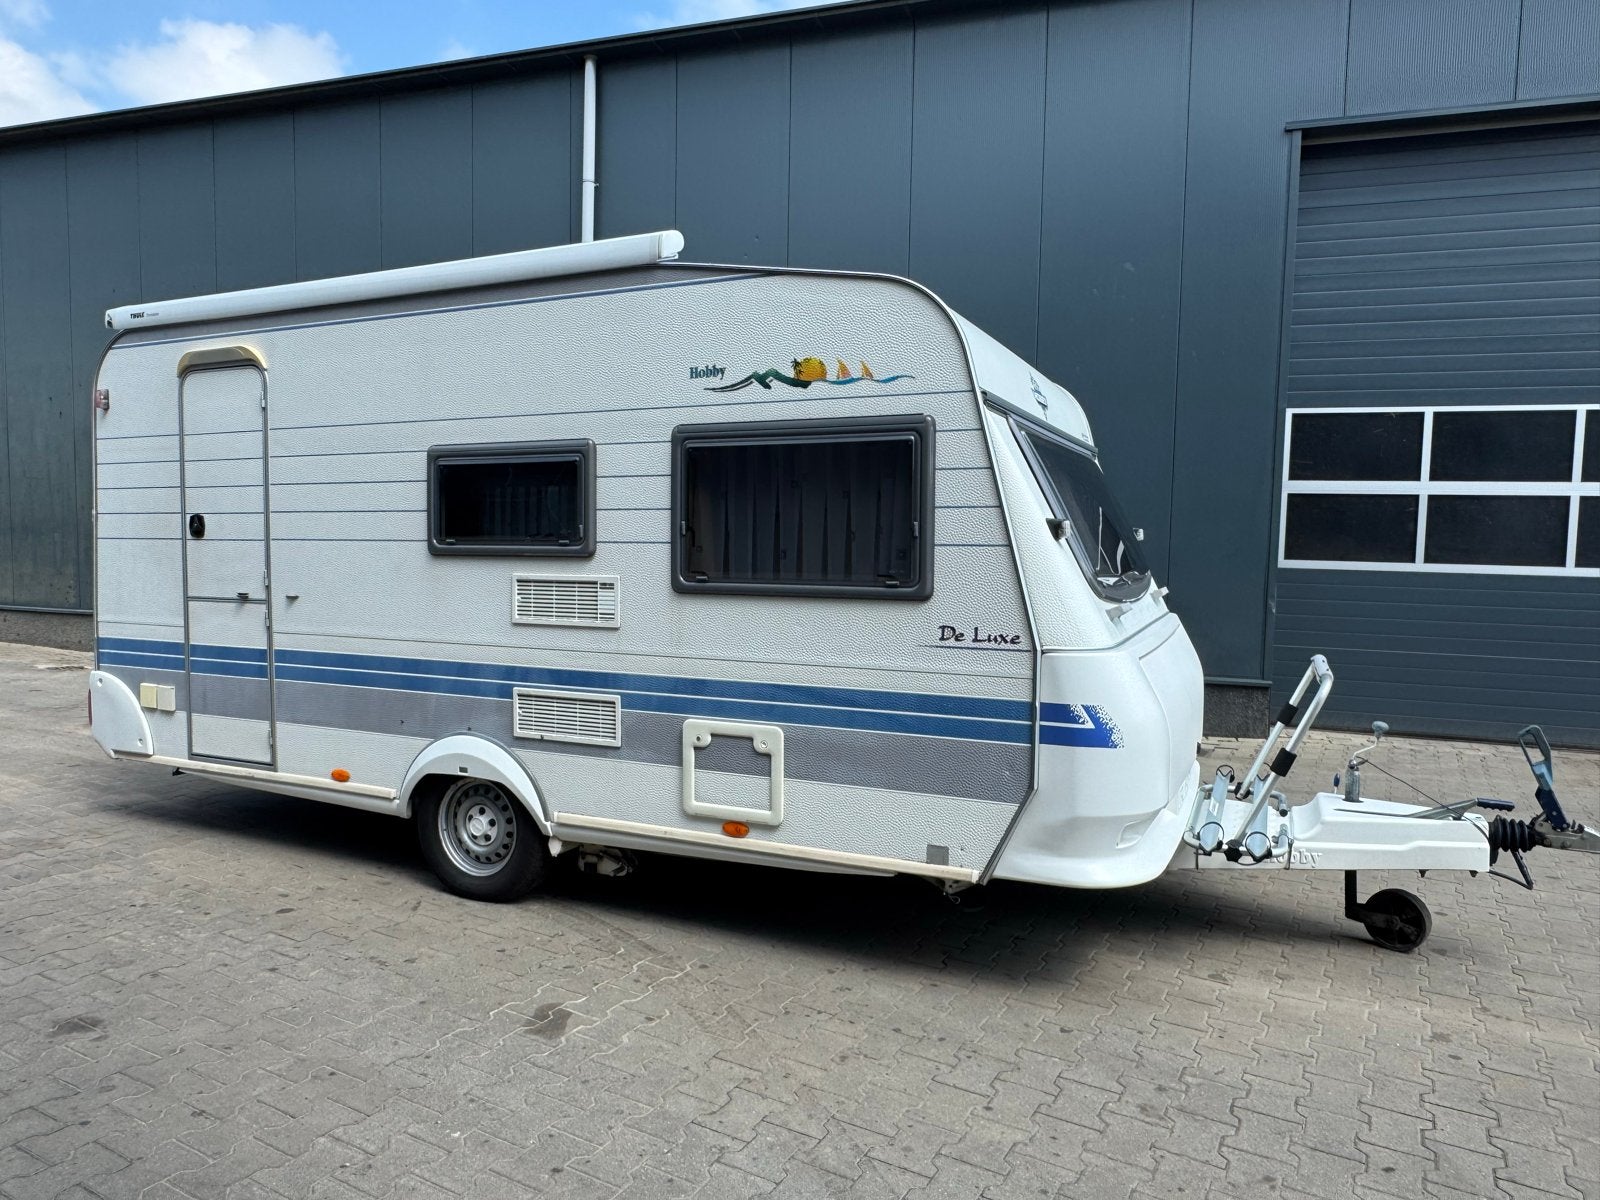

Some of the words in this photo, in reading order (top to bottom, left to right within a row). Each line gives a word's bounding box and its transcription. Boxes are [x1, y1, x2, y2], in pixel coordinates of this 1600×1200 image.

[689, 364, 726, 380] Hobby
[938, 625, 966, 642] De
[972, 627, 1021, 645] Luxe
